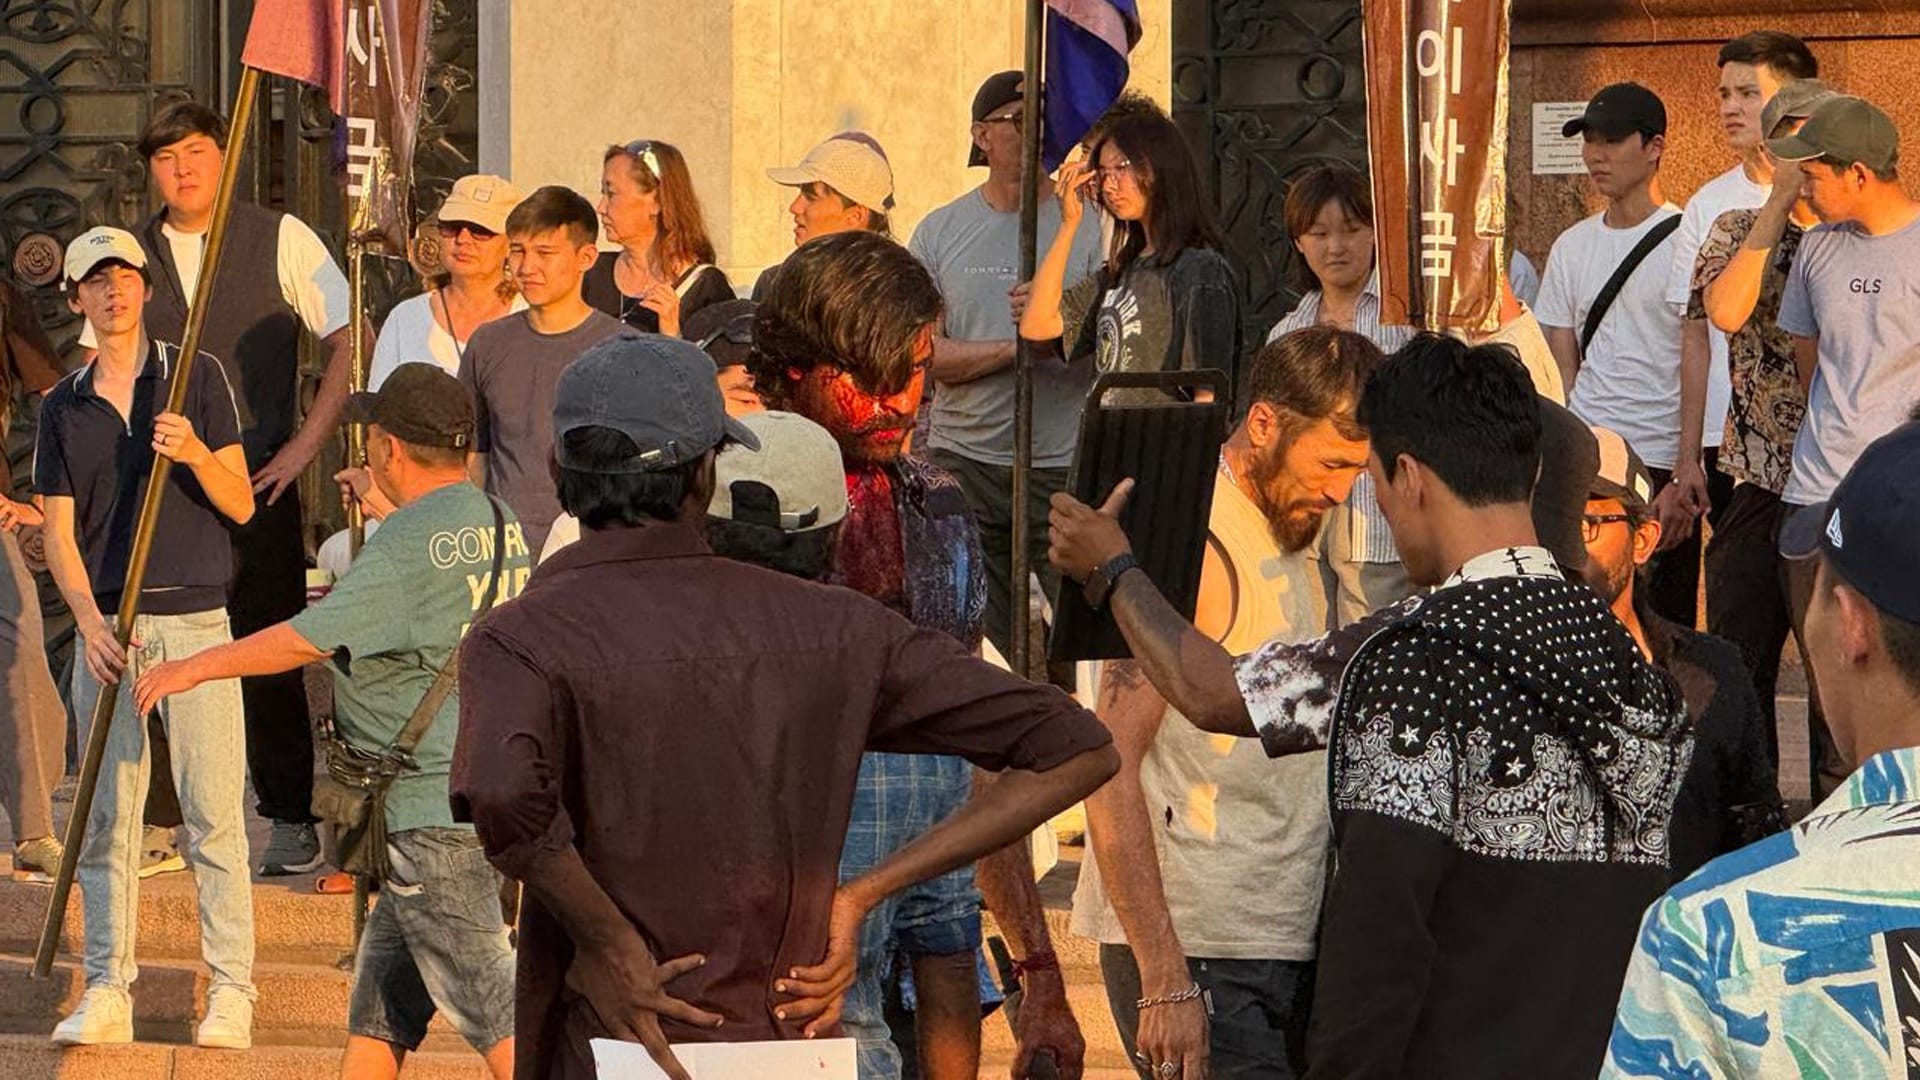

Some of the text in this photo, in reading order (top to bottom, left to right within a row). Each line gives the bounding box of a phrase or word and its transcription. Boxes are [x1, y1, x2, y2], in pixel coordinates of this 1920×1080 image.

[1416, 0, 1465, 277] 이사금
[1849, 278, 1882, 294] GLS
[429, 521, 529, 569] CONR
